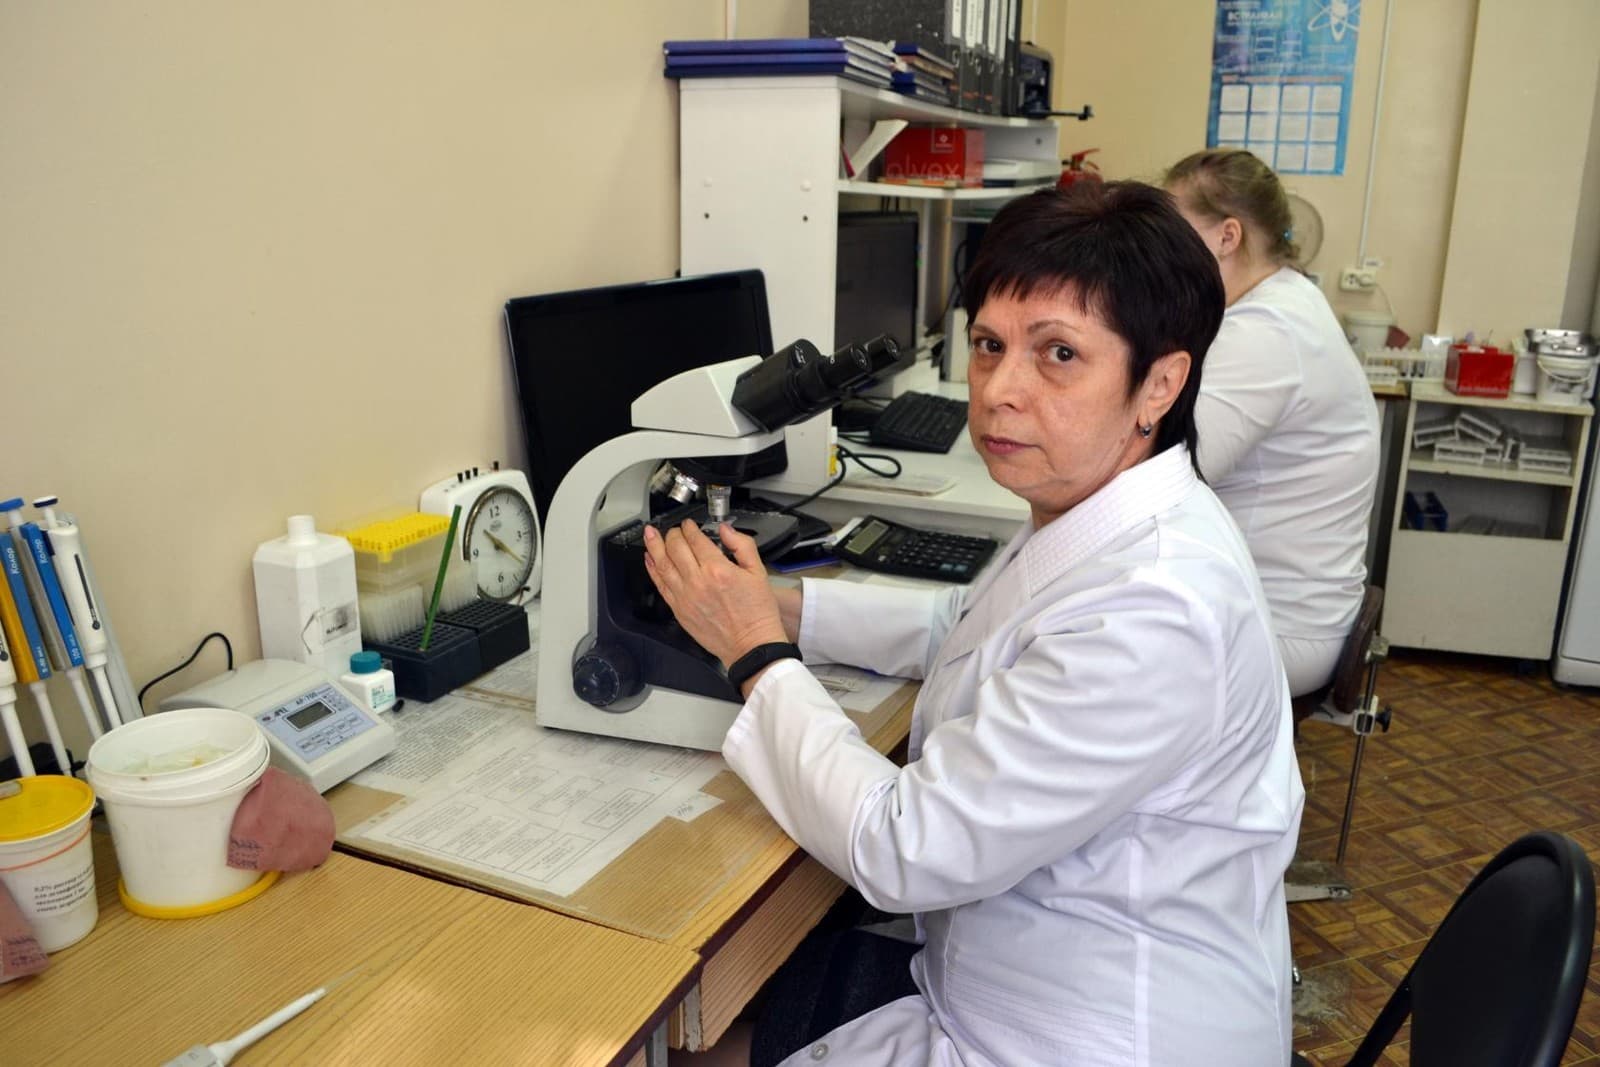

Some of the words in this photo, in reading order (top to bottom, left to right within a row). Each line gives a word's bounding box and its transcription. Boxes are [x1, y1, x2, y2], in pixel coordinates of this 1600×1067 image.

[489, 505, 500, 518] 12
[472, 548, 479, 558] 9
[498, 571, 504, 583] 6
